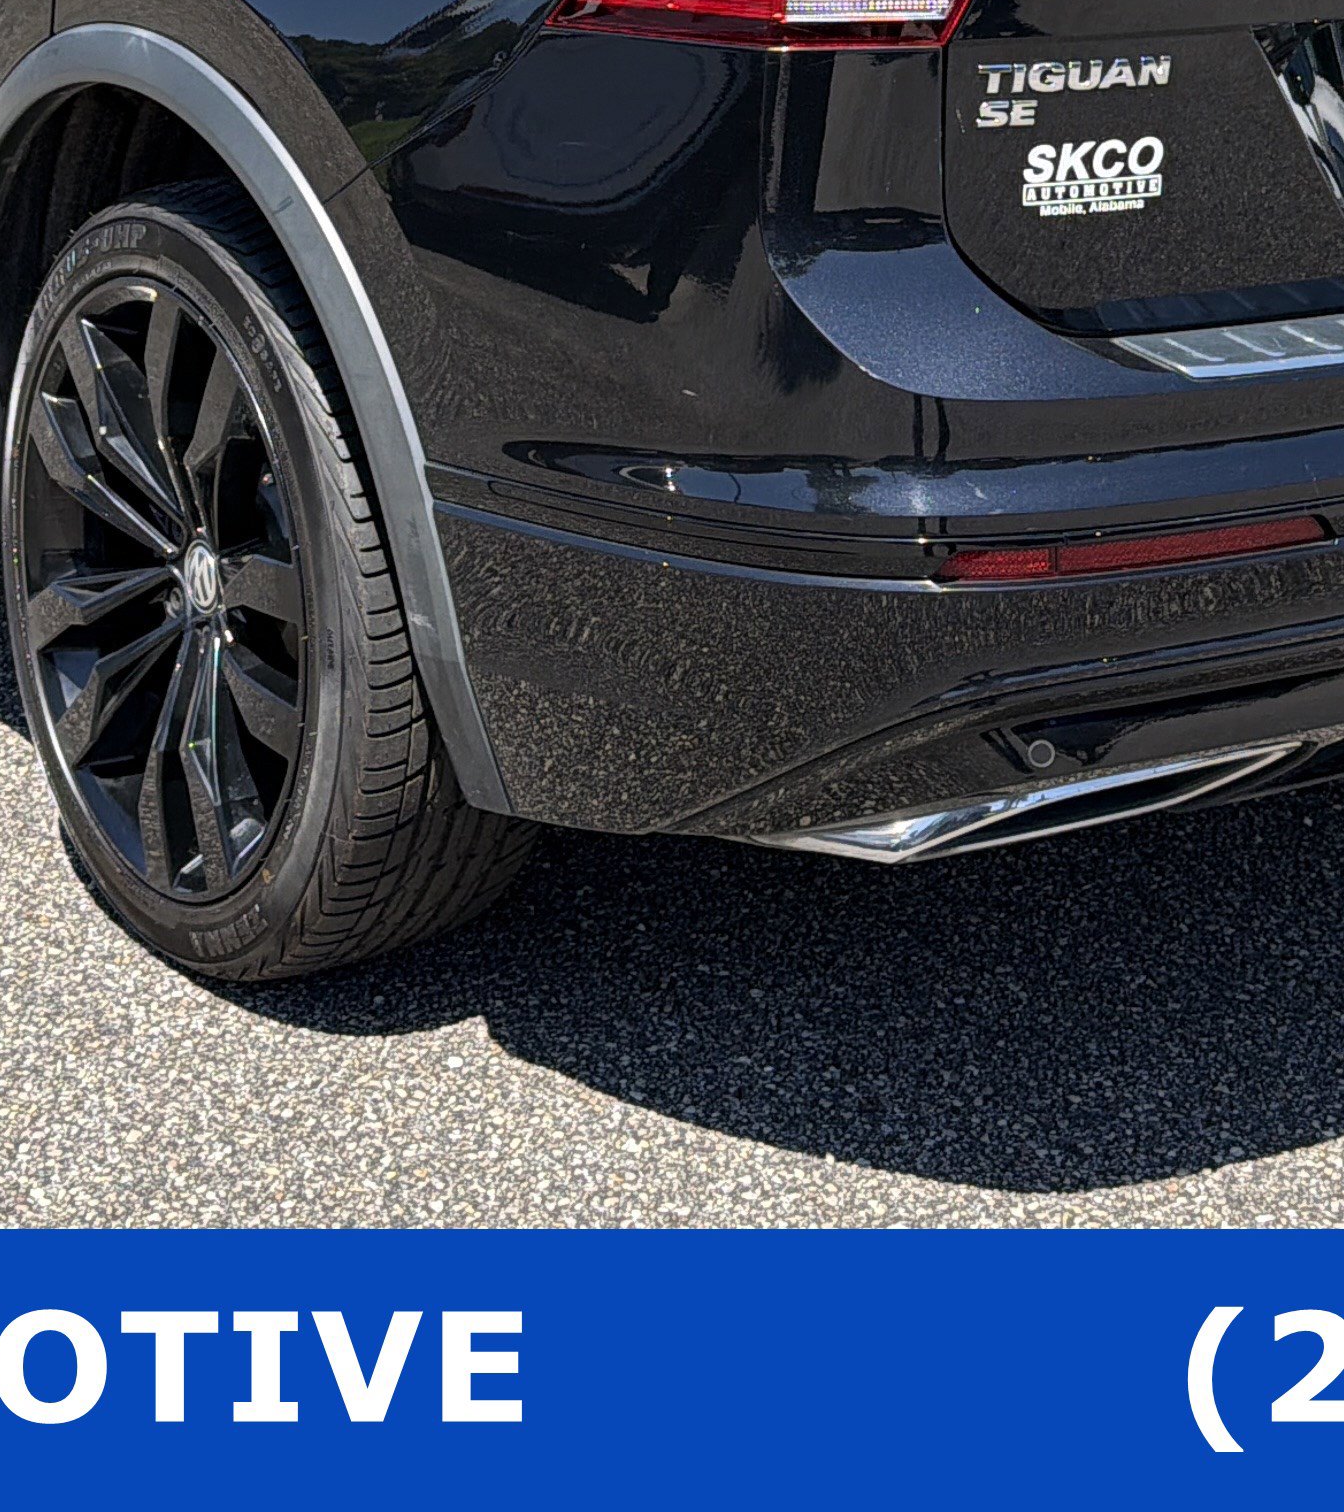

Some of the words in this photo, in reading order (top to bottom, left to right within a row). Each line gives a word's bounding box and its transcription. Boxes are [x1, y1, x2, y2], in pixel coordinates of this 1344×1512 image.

[977, 54, 1171, 94] TIGUAN
[975, 99, 1038, 128] SE
[1022, 136, 1164, 184] SKCO
[1026, 178, 1159, 202] AUTOMOTIVE
[1039, 202, 1087, 217] Mobile,
[1089, 199, 1145, 214] Alabama
